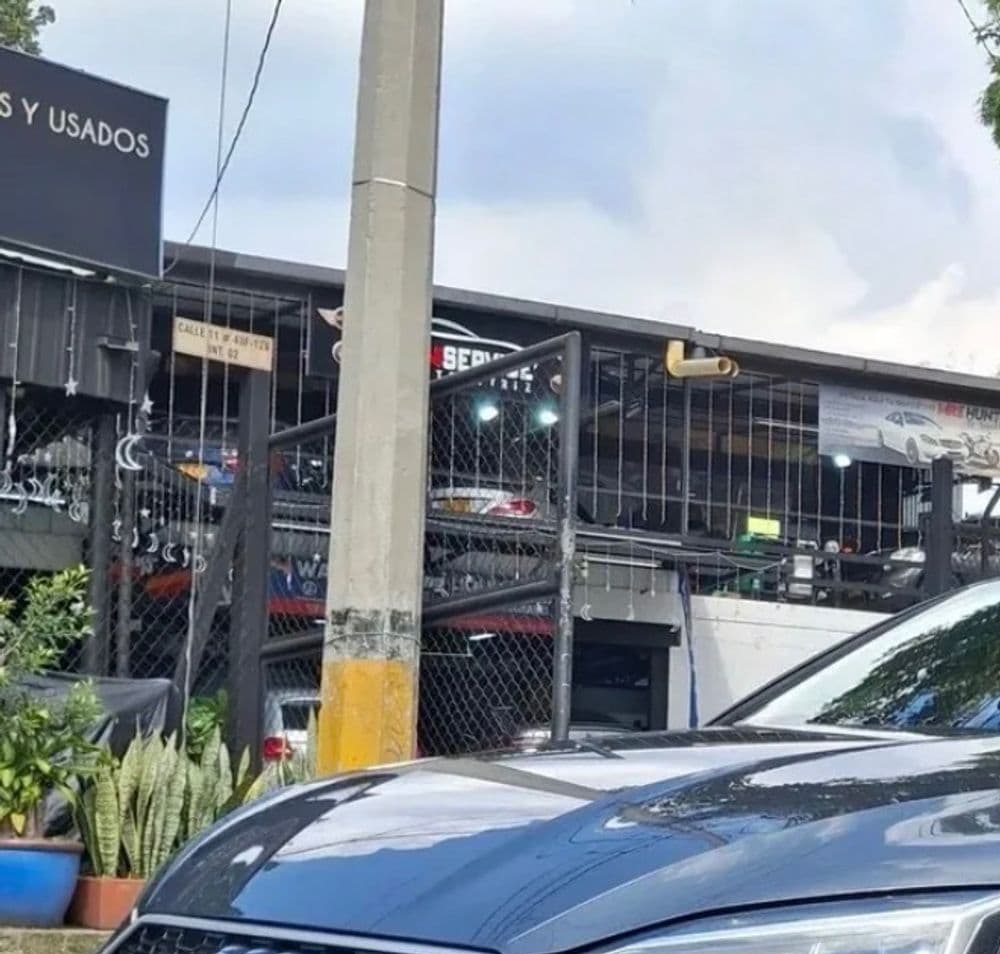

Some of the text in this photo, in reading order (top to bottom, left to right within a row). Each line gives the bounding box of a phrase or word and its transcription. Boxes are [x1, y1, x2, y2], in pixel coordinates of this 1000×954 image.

[21, 97, 39, 125] Y
[49, 106, 149, 158] USADOS
[177, 322, 206, 338] CALLE
